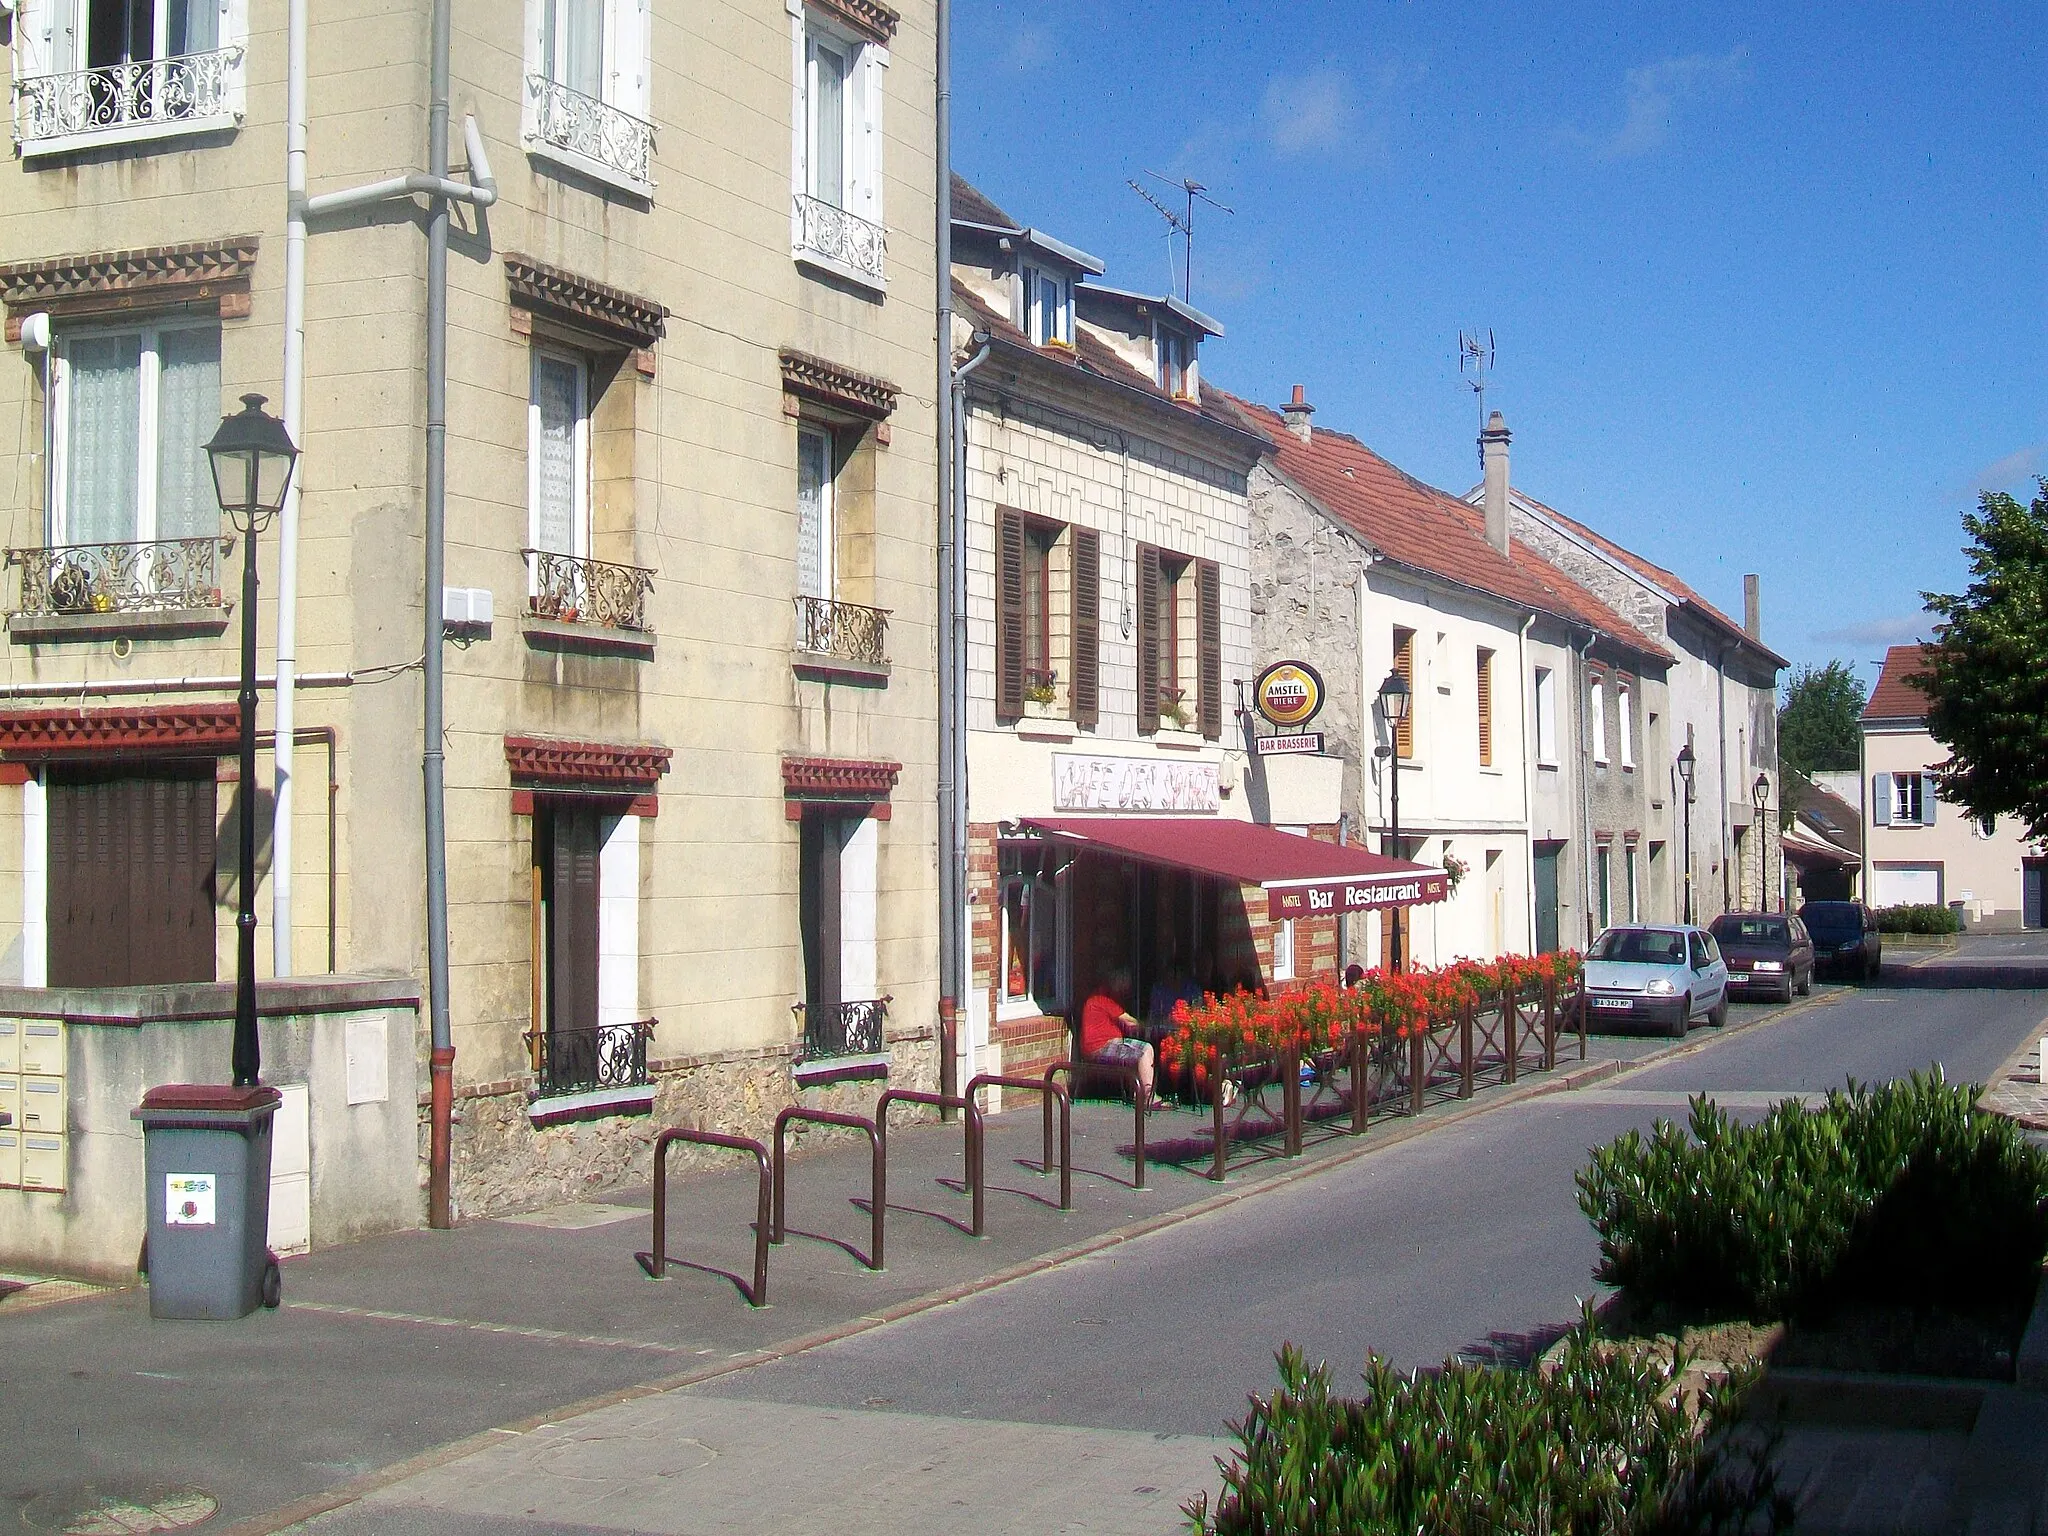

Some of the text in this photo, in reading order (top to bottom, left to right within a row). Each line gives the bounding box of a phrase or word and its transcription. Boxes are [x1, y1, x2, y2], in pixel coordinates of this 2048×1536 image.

[1268, 685, 1304, 695] AMSTEL
[1273, 697, 1299, 705] BIERE
[1260, 737, 1316, 750] BAR BRASSERIE
[1308, 881, 1421, 910] Bar Restaurant
